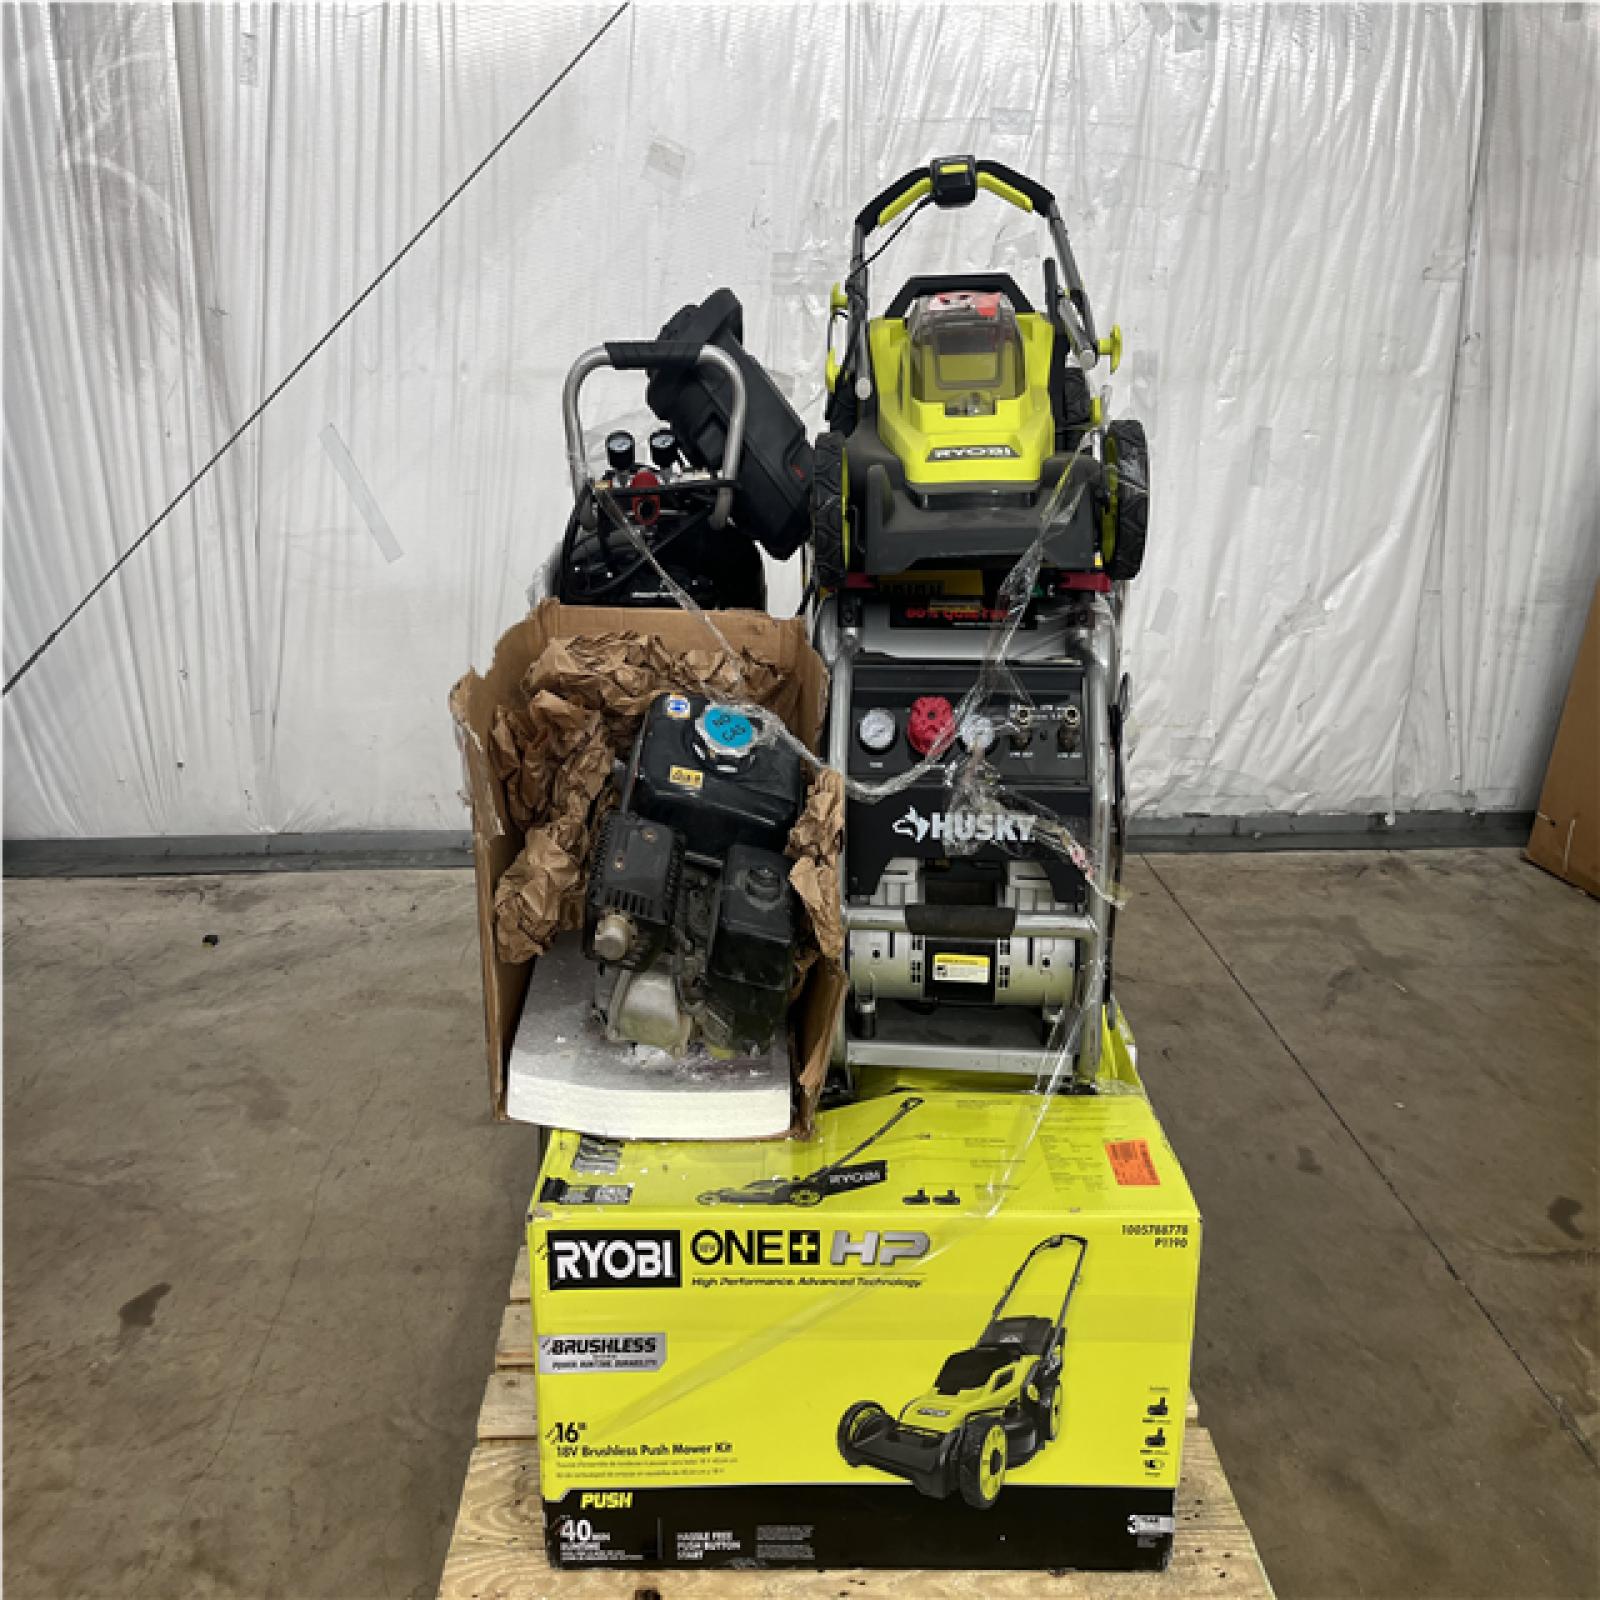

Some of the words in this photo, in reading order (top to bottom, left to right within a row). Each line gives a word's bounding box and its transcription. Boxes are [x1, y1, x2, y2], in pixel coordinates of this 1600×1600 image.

[934, 447, 1011, 459] RYOBI
[931, 811, 1036, 841] HUSKY
[552, 1239, 676, 1280] RYOBI
[829, 1229, 931, 1266] HP
[692, 1276, 718, 1288] High
[797, 1276, 855, 1287] Advanced
[551, 1337, 657, 1356] BRUSHLESS
[581, 1445, 638, 1457] Brushless
[639, 1444, 670, 1456] Push
[672, 1443, 713, 1454] Mower
[714, 1441, 733, 1453] Kit
[580, 1492, 634, 1510] PUSH
[560, 1519, 592, 1541] 40
